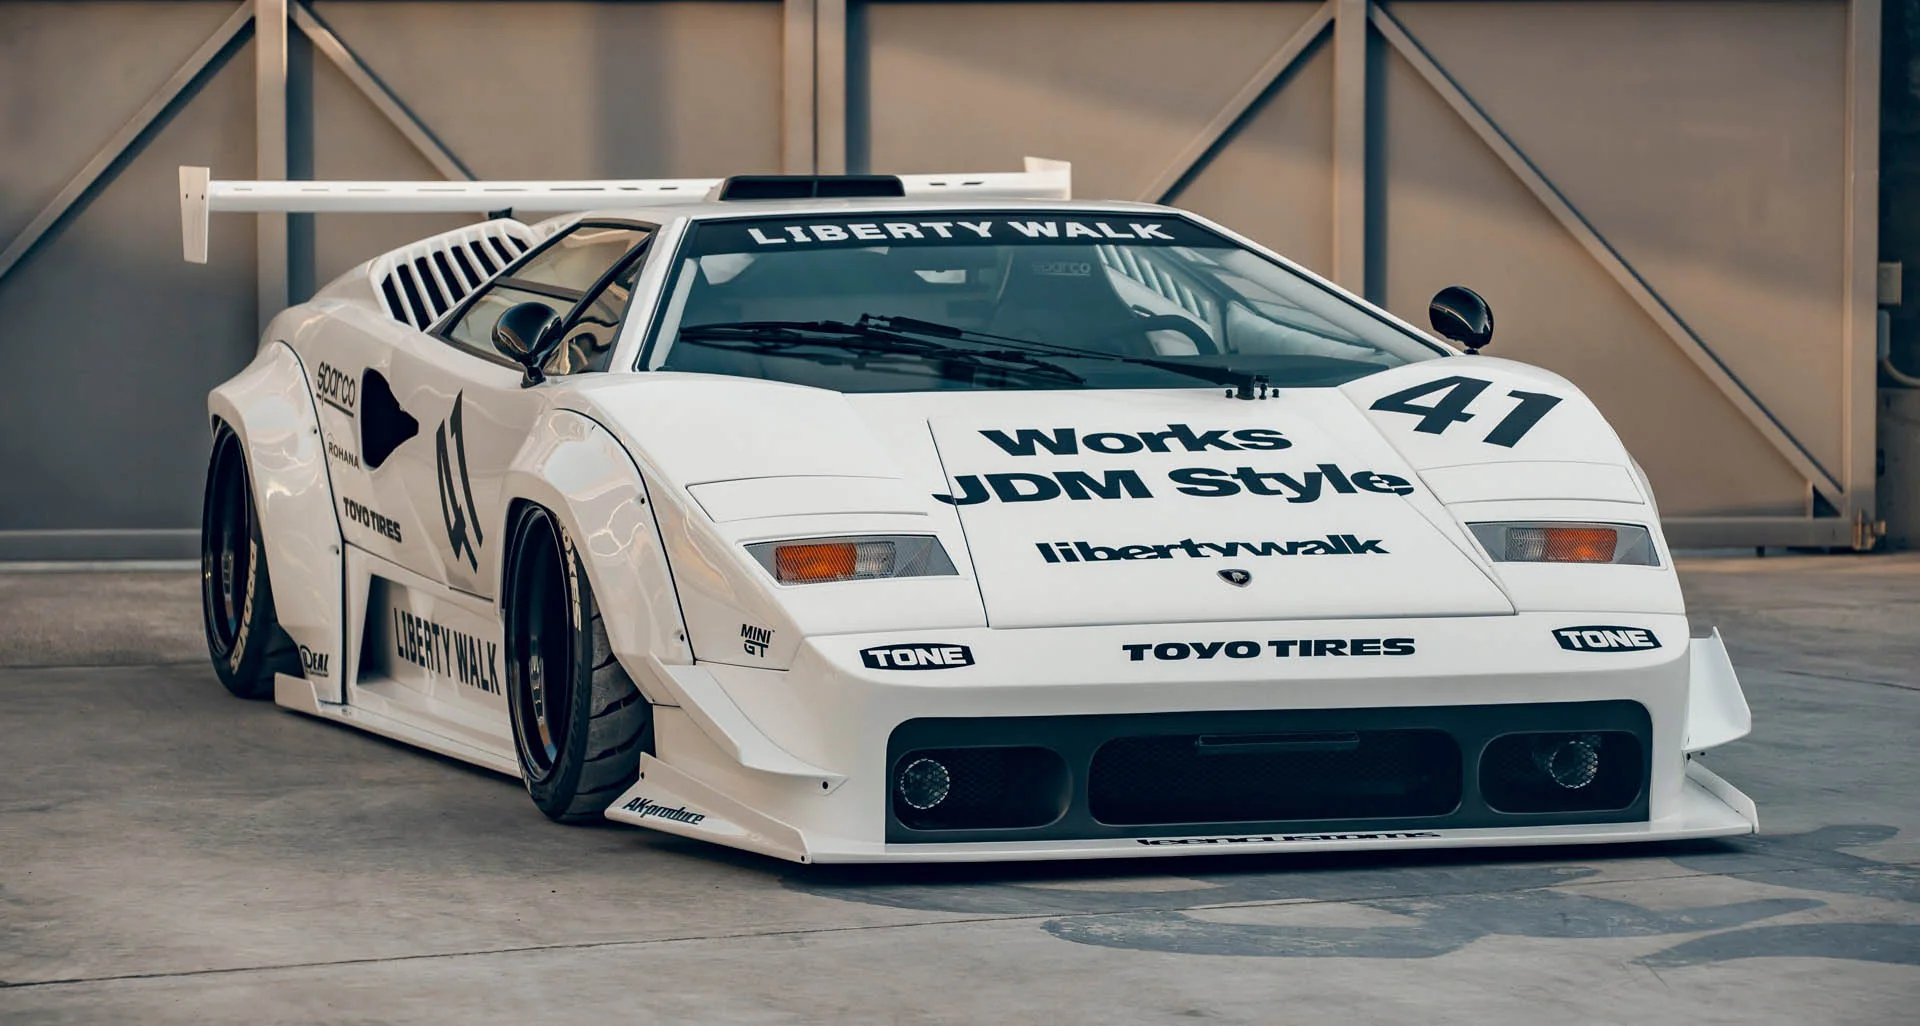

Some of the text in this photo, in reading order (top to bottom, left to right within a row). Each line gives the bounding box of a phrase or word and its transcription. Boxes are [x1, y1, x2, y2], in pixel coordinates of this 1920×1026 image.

[747, 221, 1175, 245] LIBERTY WALK
[317, 361, 355, 408] sparco
[1368, 375, 1564, 449] 41
[978, 423, 1293, 457] Works
[328, 441, 360, 470] ROHANA
[436, 389, 484, 575] 41
[932, 463, 1416, 507] JDM Style
[343, 496, 402, 543] TOYO TIRES
[1035, 534, 1391, 563] libertywalk
[740, 623, 771, 644] MINI
[1560, 630, 1655, 648] TONE
[393, 607, 501, 696] LIBERTY WALK
[744, 640, 769, 658] GT
[868, 647, 967, 667] TONE
[1122, 637, 1416, 662] TOYO TIRES
